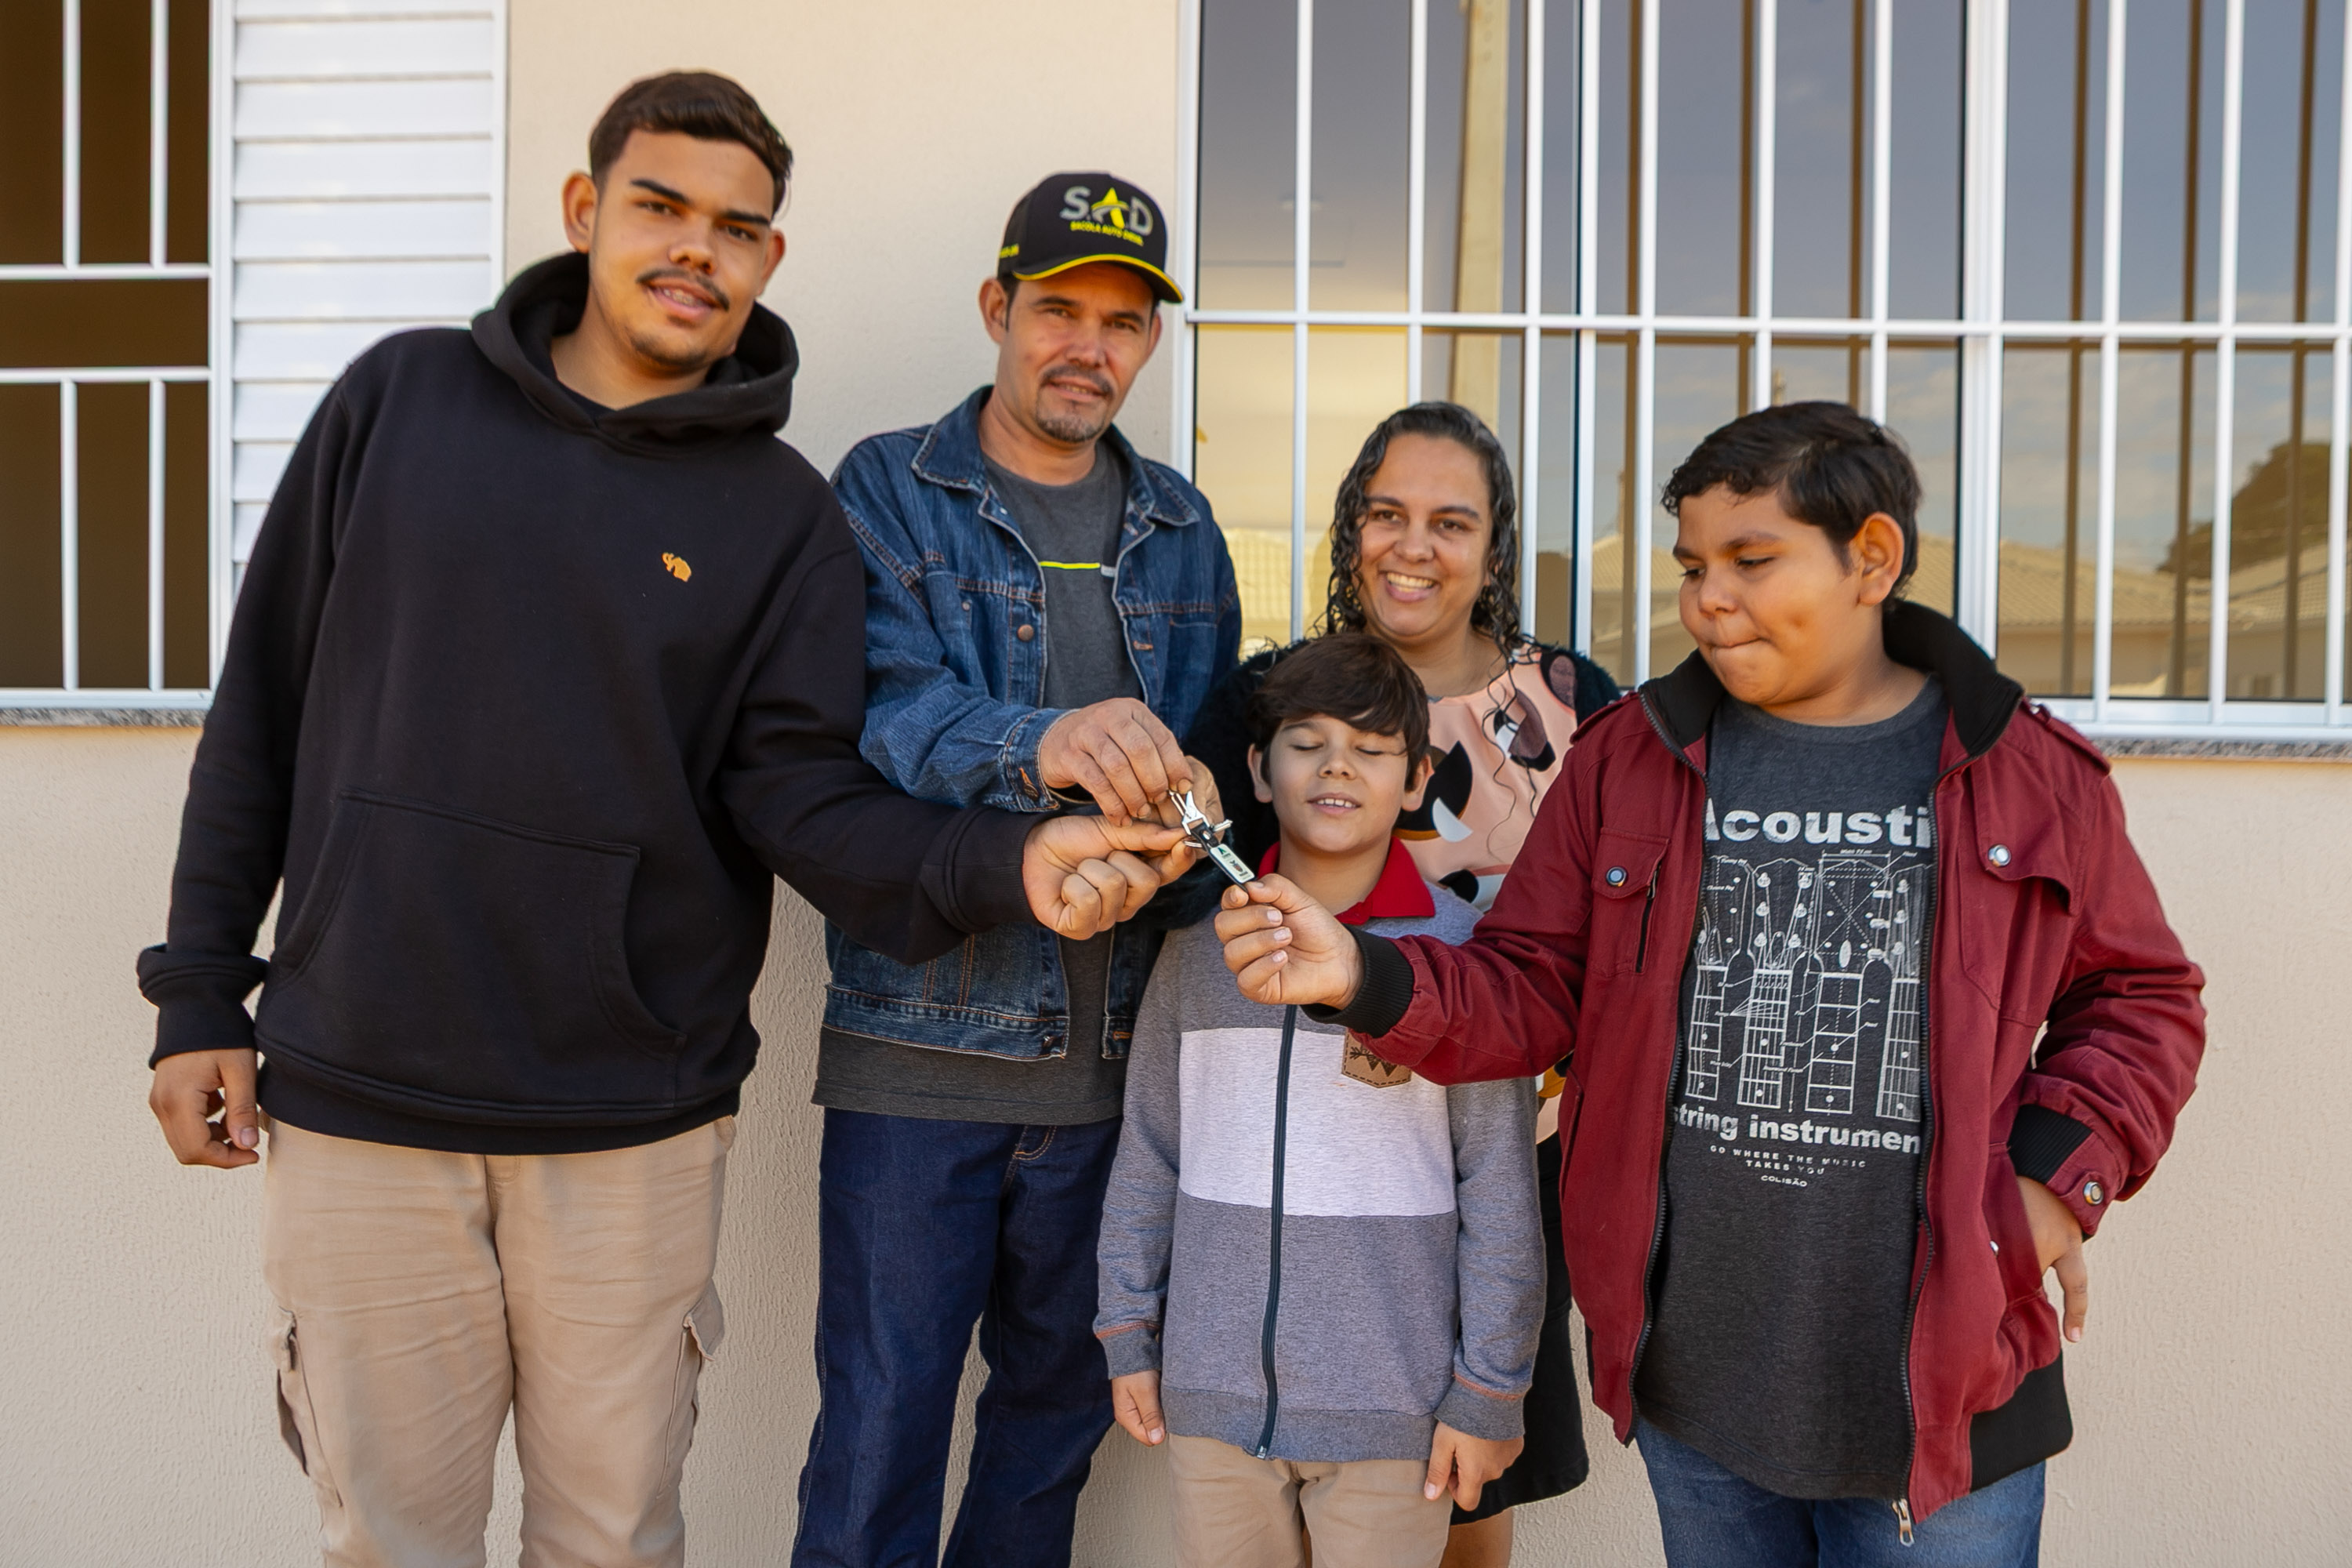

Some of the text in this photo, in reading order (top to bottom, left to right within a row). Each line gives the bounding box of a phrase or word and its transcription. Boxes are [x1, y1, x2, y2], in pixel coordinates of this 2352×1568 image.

[1749, 1114, 1921, 1154] instrumen
[1710, 1145, 1726, 1154] GO
[1733, 1149, 1780, 1160] WHERE
[1788, 1154, 1813, 1164] THE
[1745, 1160, 1825, 1175] TAKES YOU
[1761, 1175, 1808, 1188] COLISÃO
